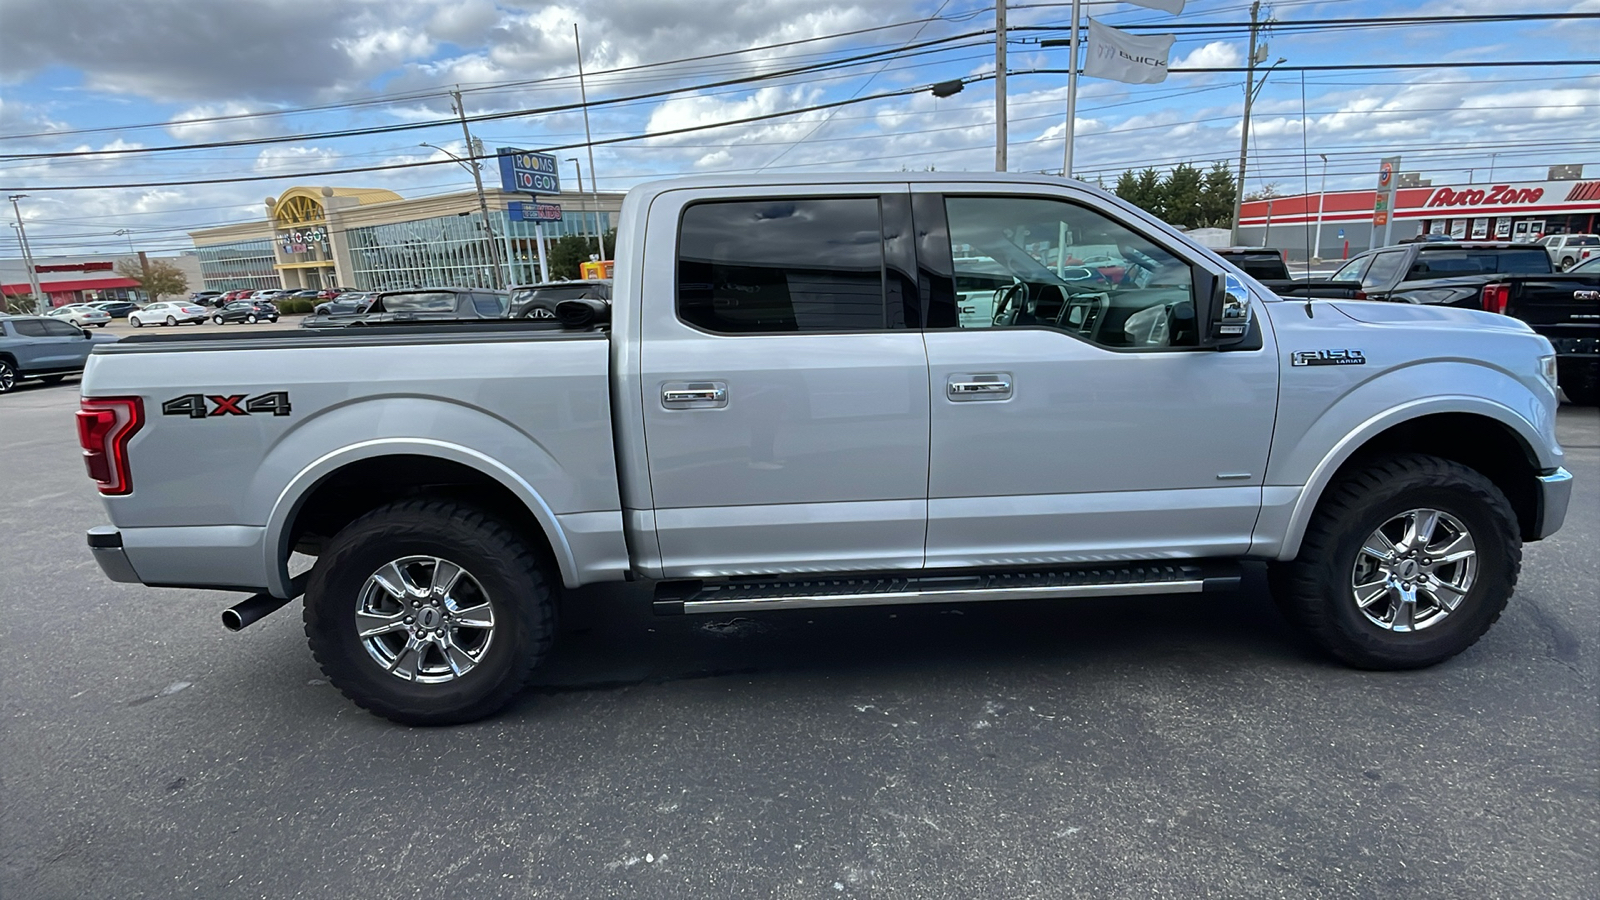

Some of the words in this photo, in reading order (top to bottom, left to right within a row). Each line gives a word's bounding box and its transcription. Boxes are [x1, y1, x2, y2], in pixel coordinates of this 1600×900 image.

[1119, 50, 1166, 66] BUICK
[516, 154, 553, 172] ROOMS
[518, 173, 532, 187] TO
[534, 174, 550, 189] GO
[538, 205, 561, 220] KIDS
